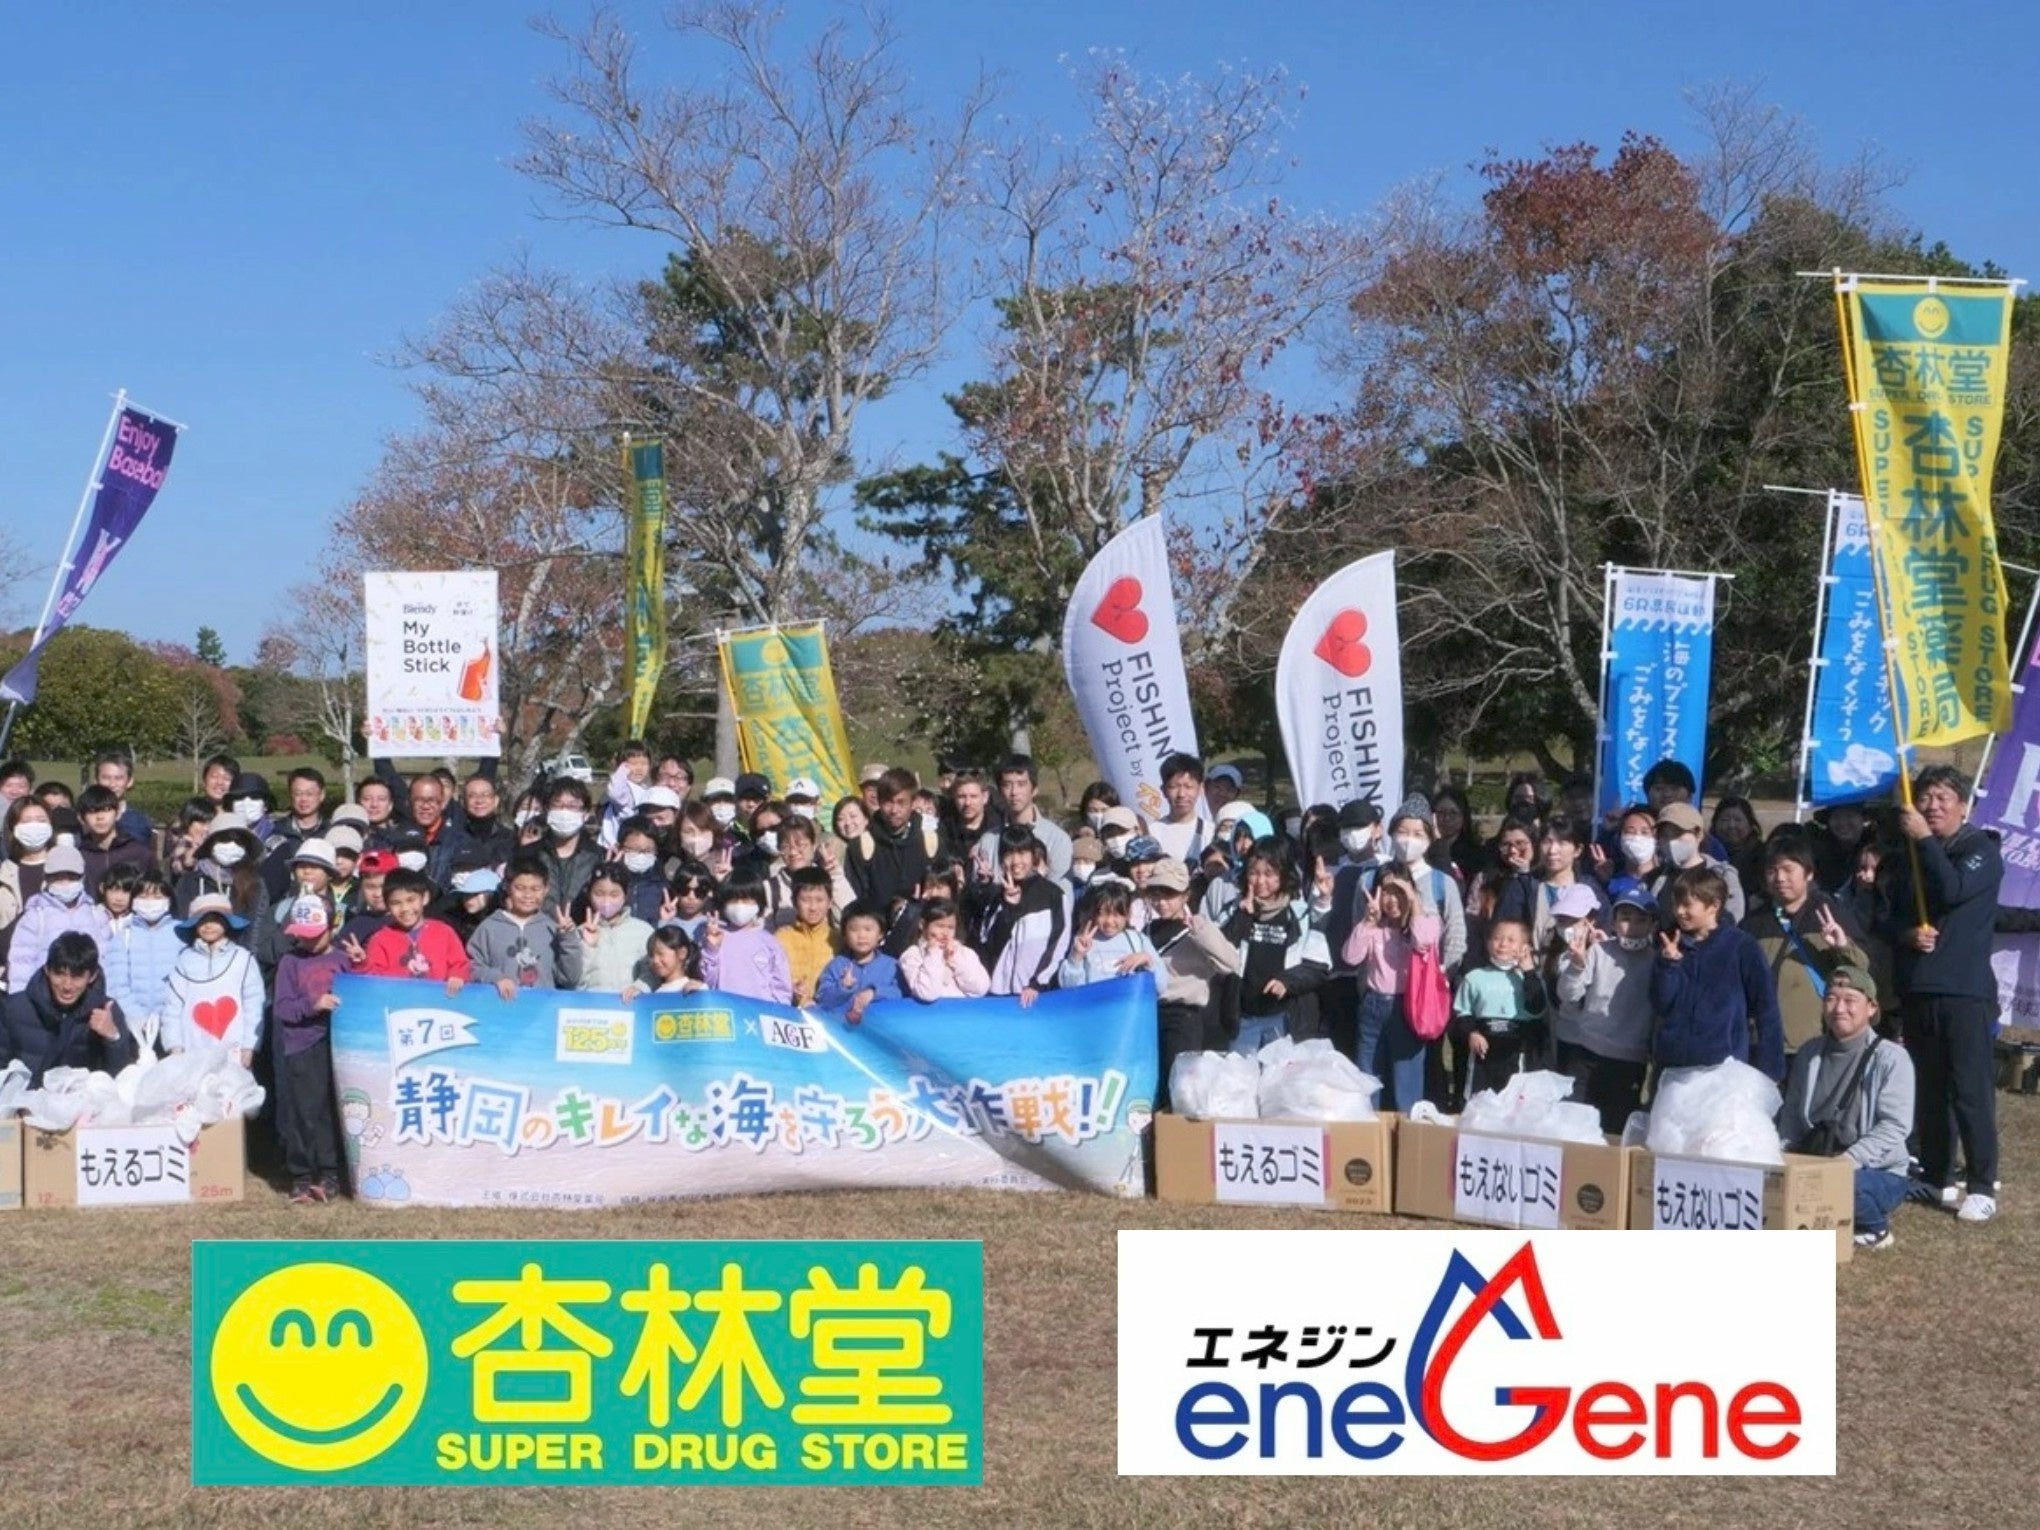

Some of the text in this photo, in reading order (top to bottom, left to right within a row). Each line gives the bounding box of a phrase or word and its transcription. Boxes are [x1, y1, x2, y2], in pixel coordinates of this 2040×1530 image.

[1873, 346, 1990, 394] 杏林堂
[118, 416, 161, 457] Enjoy
[403, 621, 430, 637] My
[403, 640, 462, 654] Bottle
[403, 658, 451, 673] Stick
[1973, 625, 1997, 722] STORE
[1102, 659, 1143, 777] Project by
[1128, 652, 1175, 761] FISHIN
[1323, 691, 1351, 790] Project
[398, 1018, 455, 1047] 第7回
[770, 1019, 816, 1049] AGF
[80, 1144, 186, 1188] もえるゴミ
[1218, 1142, 1321, 1187] もえるゴミ
[1459, 1156, 1559, 1211] もえないゴミ
[1656, 1180, 1760, 1230] もえないゴミ
